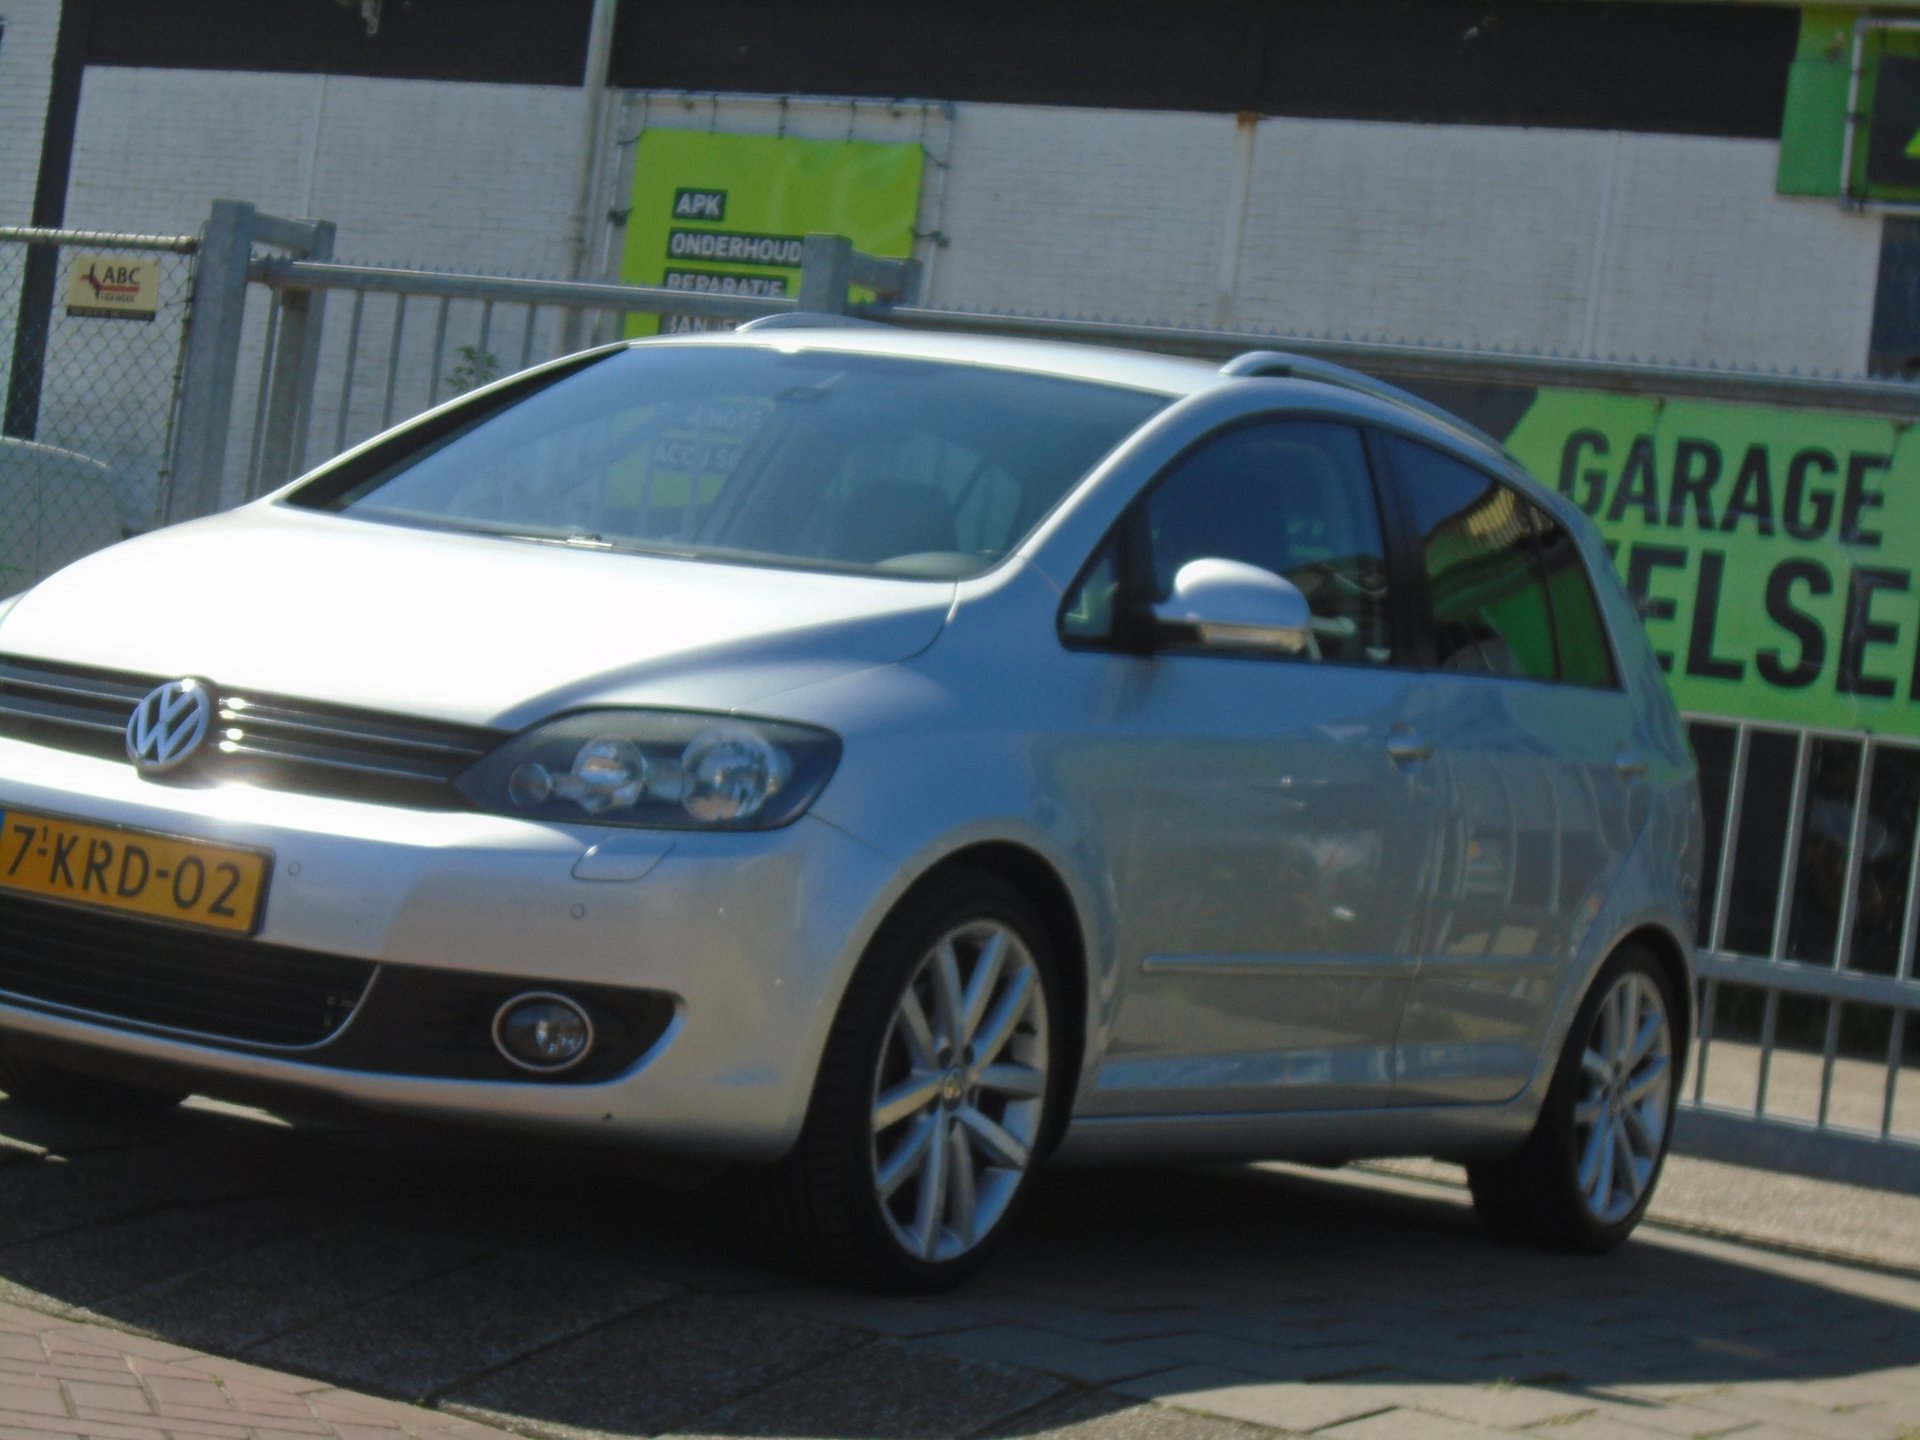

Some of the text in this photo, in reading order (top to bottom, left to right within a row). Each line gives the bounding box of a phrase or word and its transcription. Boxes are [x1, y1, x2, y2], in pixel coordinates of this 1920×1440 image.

[676, 193, 720, 215] APK
[671, 232, 801, 262] ONDERHOUD
[102, 266, 141, 285] ABC
[1558, 429, 1892, 547] GARAGE
[1607, 537, 1920, 703] ELSE
